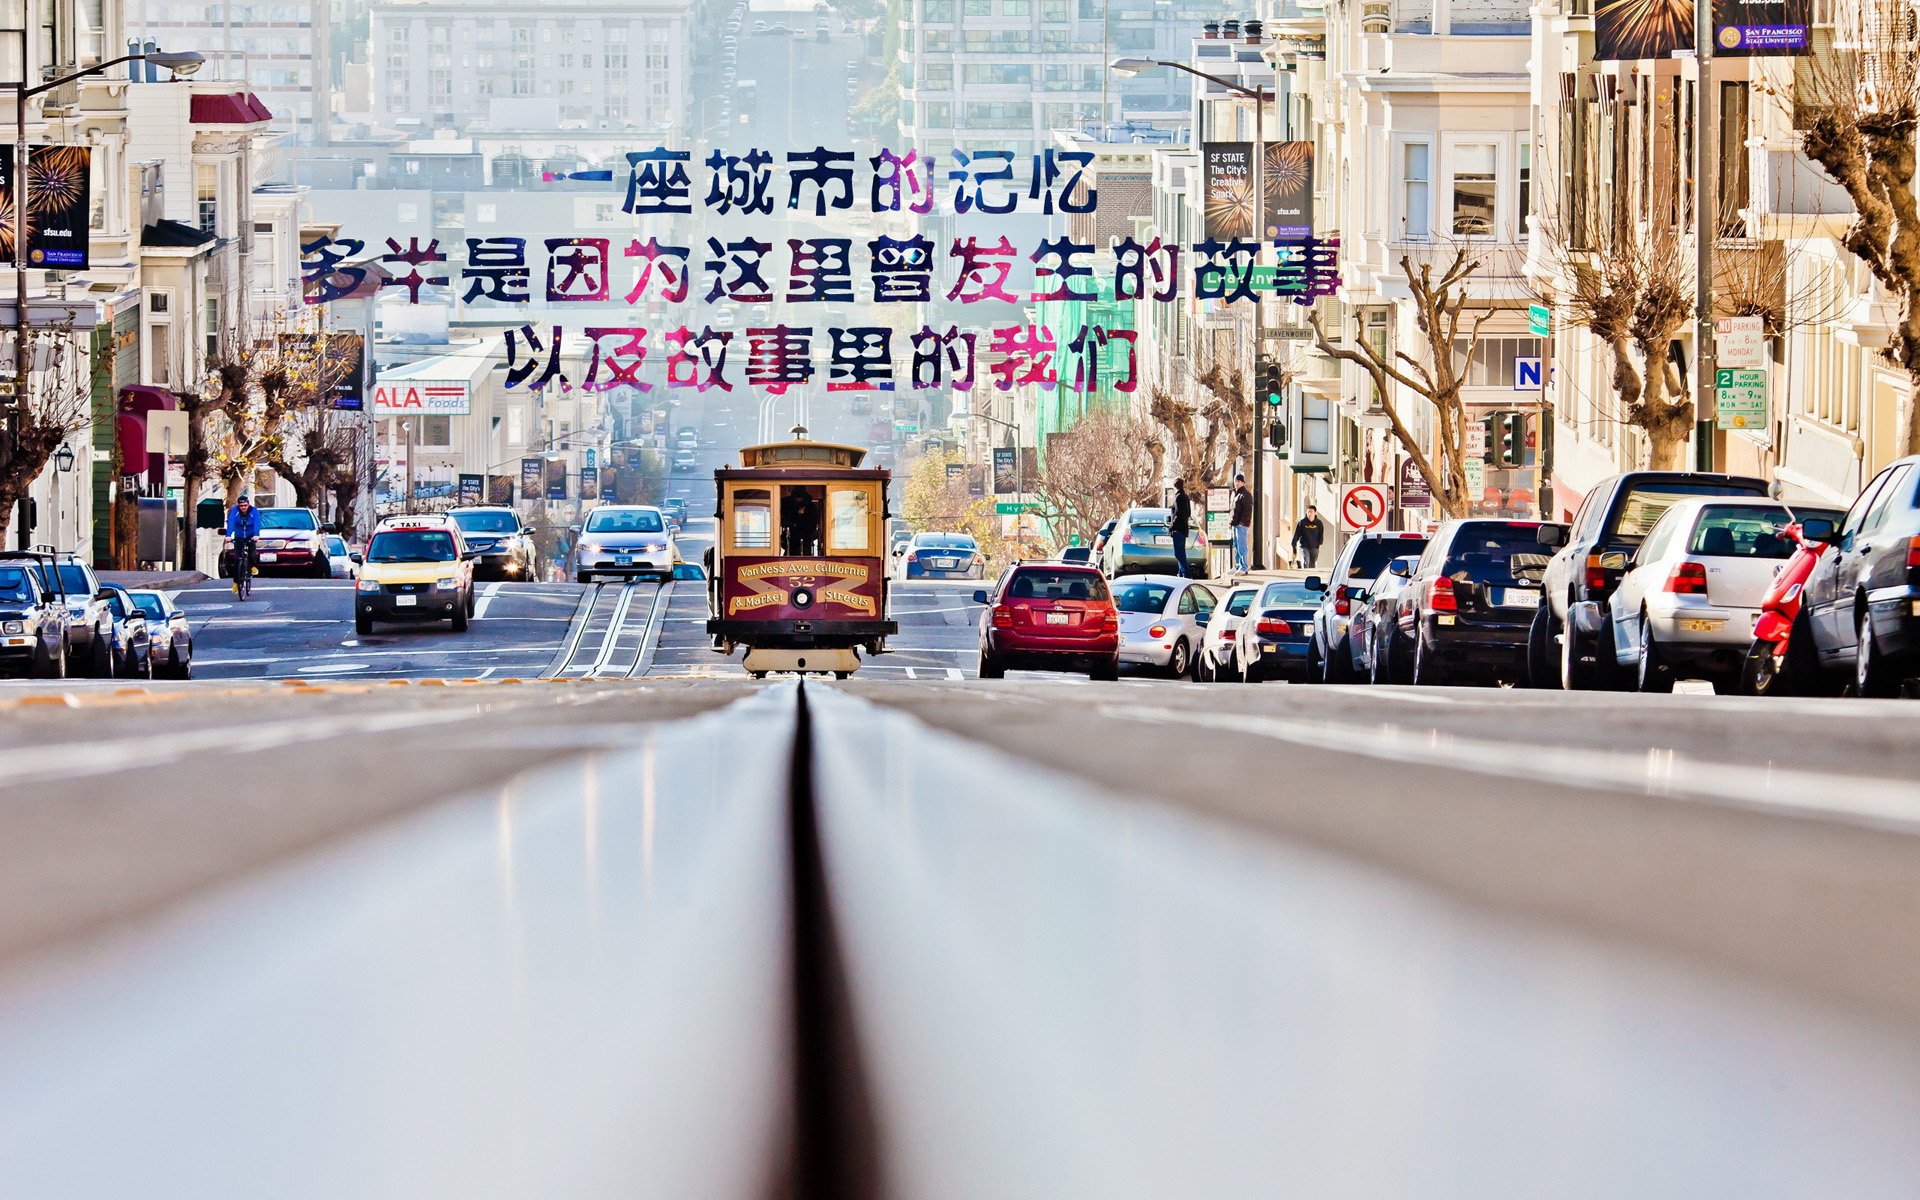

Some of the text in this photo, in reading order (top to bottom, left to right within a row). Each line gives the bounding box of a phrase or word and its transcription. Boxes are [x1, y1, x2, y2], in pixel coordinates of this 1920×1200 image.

[1211, 153, 1245, 162] SF STATE
[1211, 166, 1247, 176] The City's
[1211, 178, 1243, 187] Creative
[1211, 190, 1234, 200] Spark
[1277, 207, 1300, 215] sfsu.edu
[43, 228, 72, 237] sfsu.edu
[1718, 319, 1761, 332] NO PARKING
[1728, 348, 1753, 356] MONDAY
[1720, 372, 1731, 385] 2
[427, 397, 465, 408] Foods
[740, 568, 759, 577] Van
[760, 565, 785, 574] Ness
[815, 563, 867, 576] California
[789, 576, 815, 588] 52
[735, 592, 783, 607] & Market
[825, 590, 868, 606] Streets
